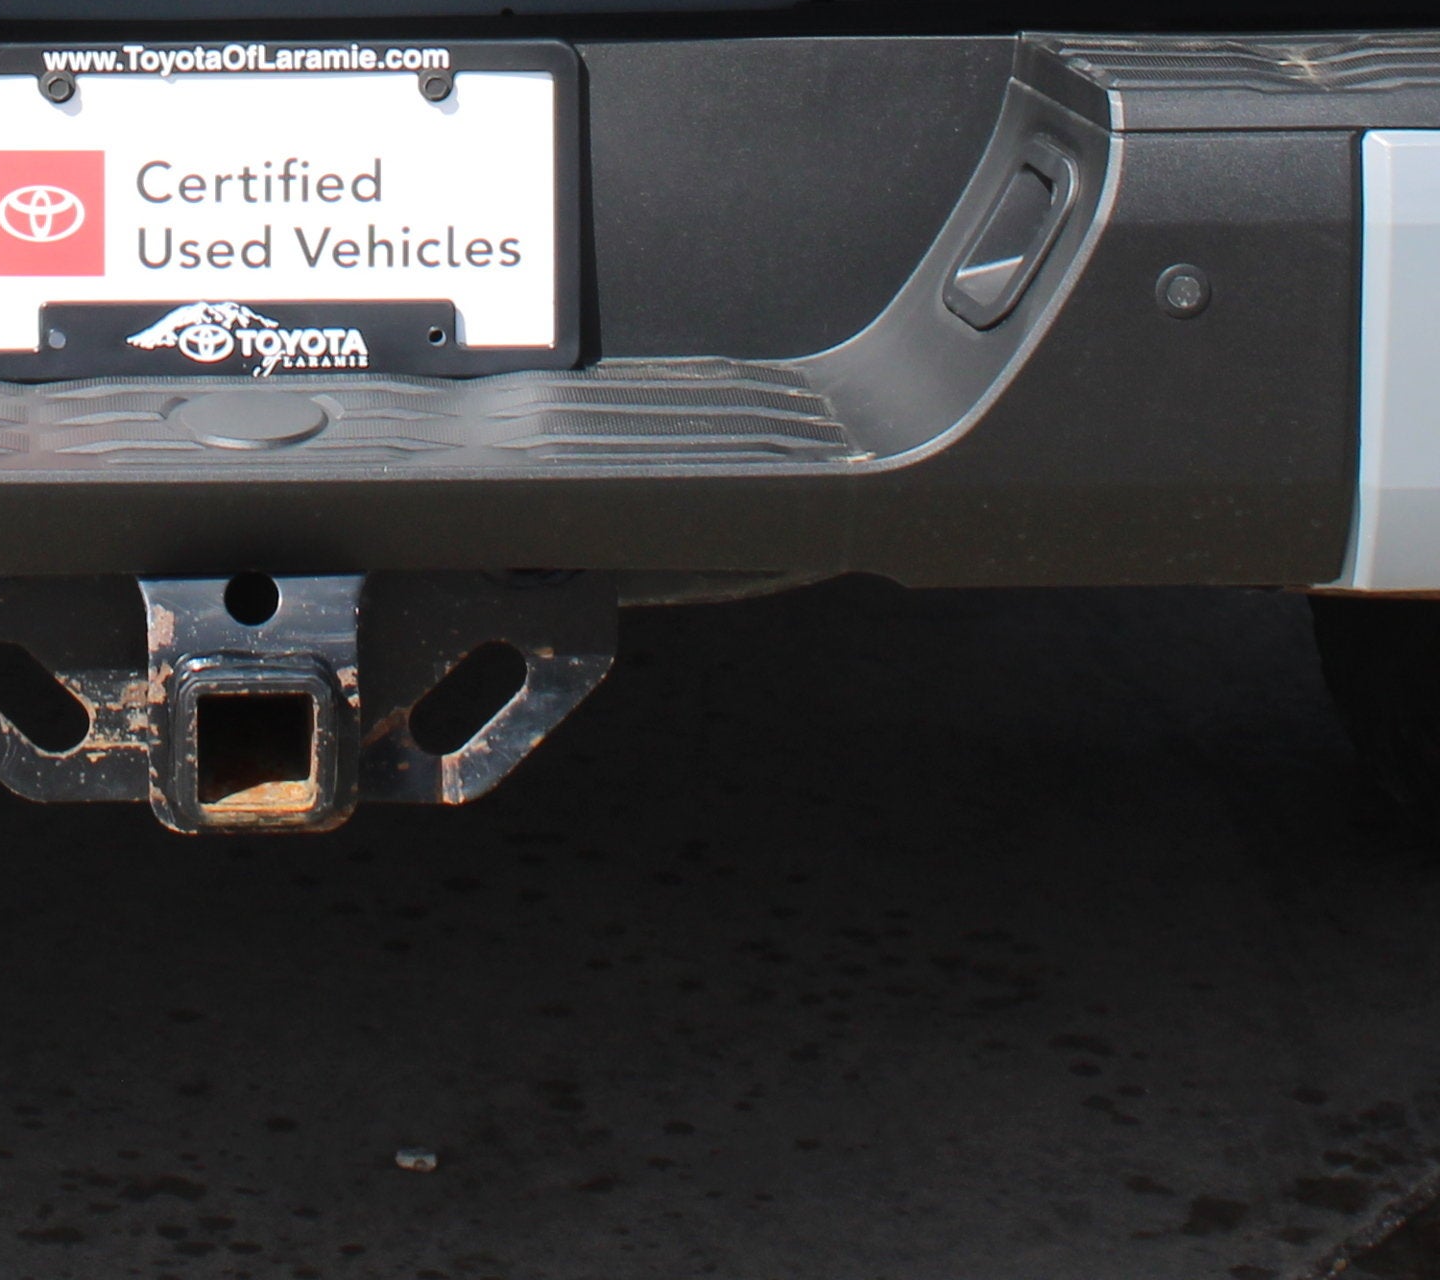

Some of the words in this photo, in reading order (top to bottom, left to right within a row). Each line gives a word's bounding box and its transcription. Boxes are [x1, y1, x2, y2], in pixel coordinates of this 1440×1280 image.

[42, 43, 451, 76] www.ToyotaOfLaramie.com
[135, 157, 382, 204] Certified
[137, 223, 273, 270] Used
[293, 223, 523, 270] Vehicles
[235, 327, 369, 358] TOYOTA
[251, 349, 284, 379] of
[282, 355, 369, 369] LARAMIE
